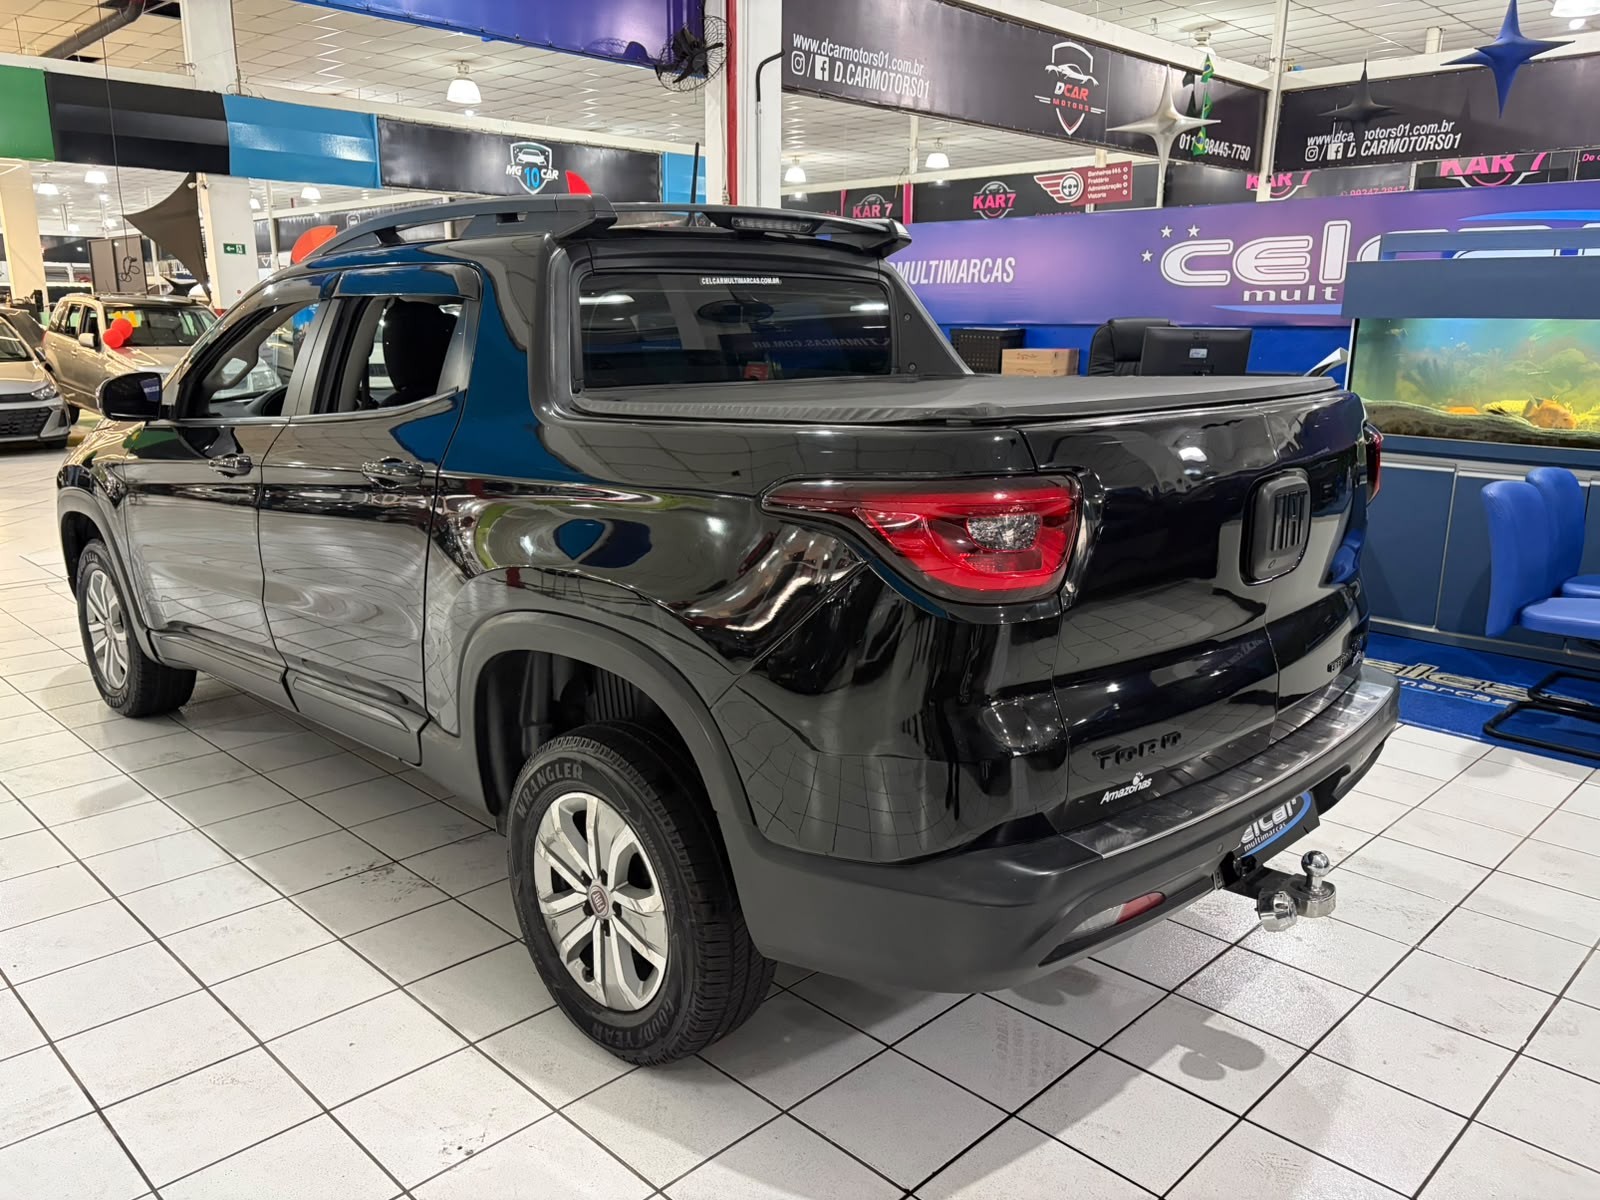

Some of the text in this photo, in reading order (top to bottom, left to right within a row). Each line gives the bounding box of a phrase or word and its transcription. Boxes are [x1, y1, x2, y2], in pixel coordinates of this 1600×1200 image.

[793, 33, 924, 76] www.dcarmotors01.com.br
[833, 61, 930, 99] D.CARMOTORS01
[1054, 82, 1090, 101] DCAR
[1052, 98, 1090, 113] MOTORS
[1307, 119, 1455, 146] www.dcaotors01.com.br
[1204, 139, 1251, 162] 98445-7750
[1347, 133, 1462, 158] DCARMOTORS01
[505, 165, 559, 189] MG 10 CAR
[1440, 154, 1516, 177] KAR
[852, 204, 881, 219] KAR
[884, 203, 893, 217] 7
[889, 256, 1016, 285] MULTIMARCAS
[1271, 489, 1309, 552] FIAT
[517, 761, 583, 816] WRANGLER
